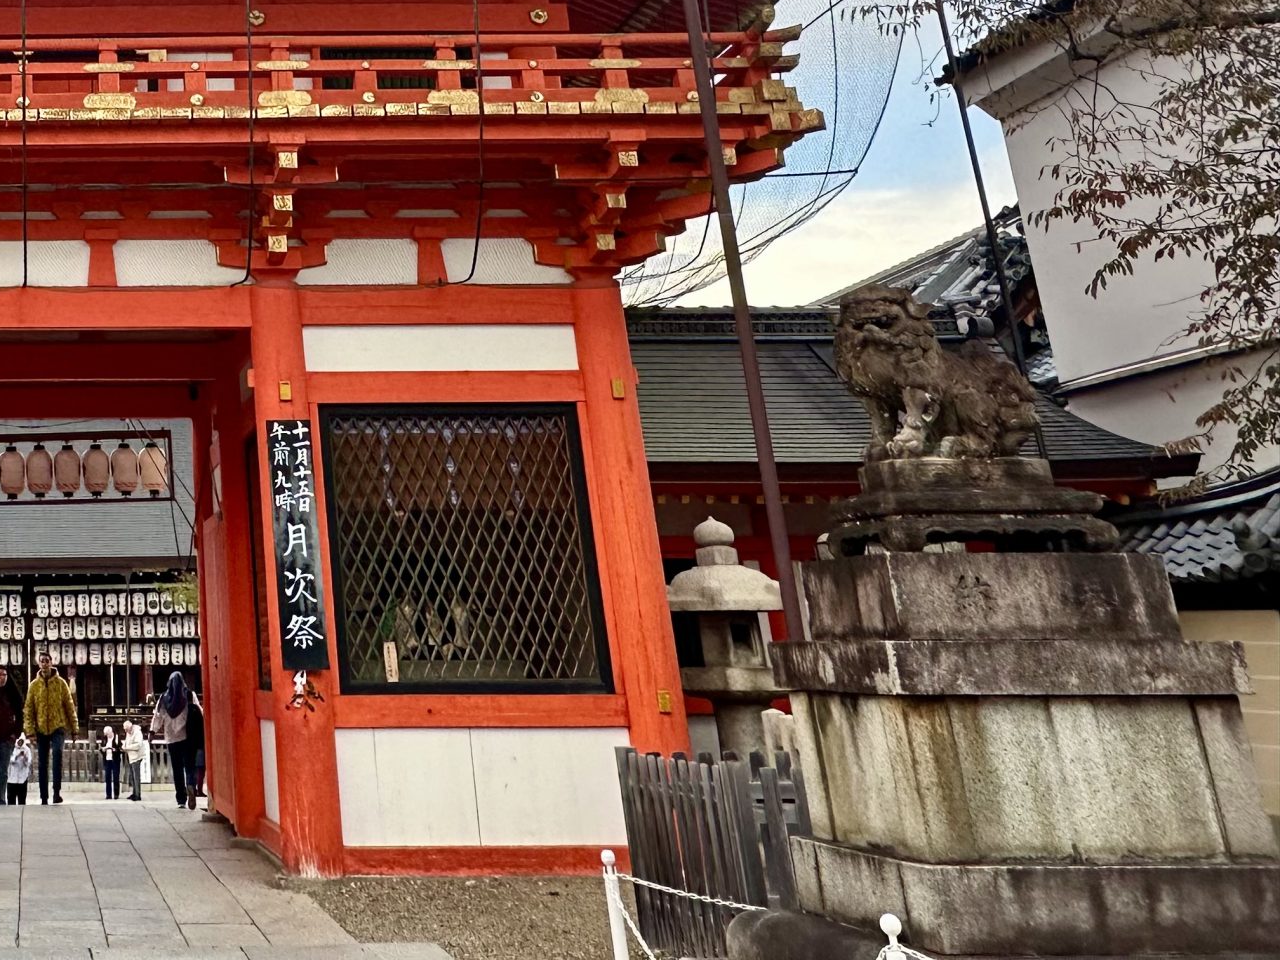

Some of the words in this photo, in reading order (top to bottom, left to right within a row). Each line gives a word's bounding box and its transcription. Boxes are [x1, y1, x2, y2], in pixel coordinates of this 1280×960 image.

[269, 421, 296, 512] 午前九時
[292, 420, 315, 513] 十一月十五日
[283, 522, 324, 649] 月次祭
